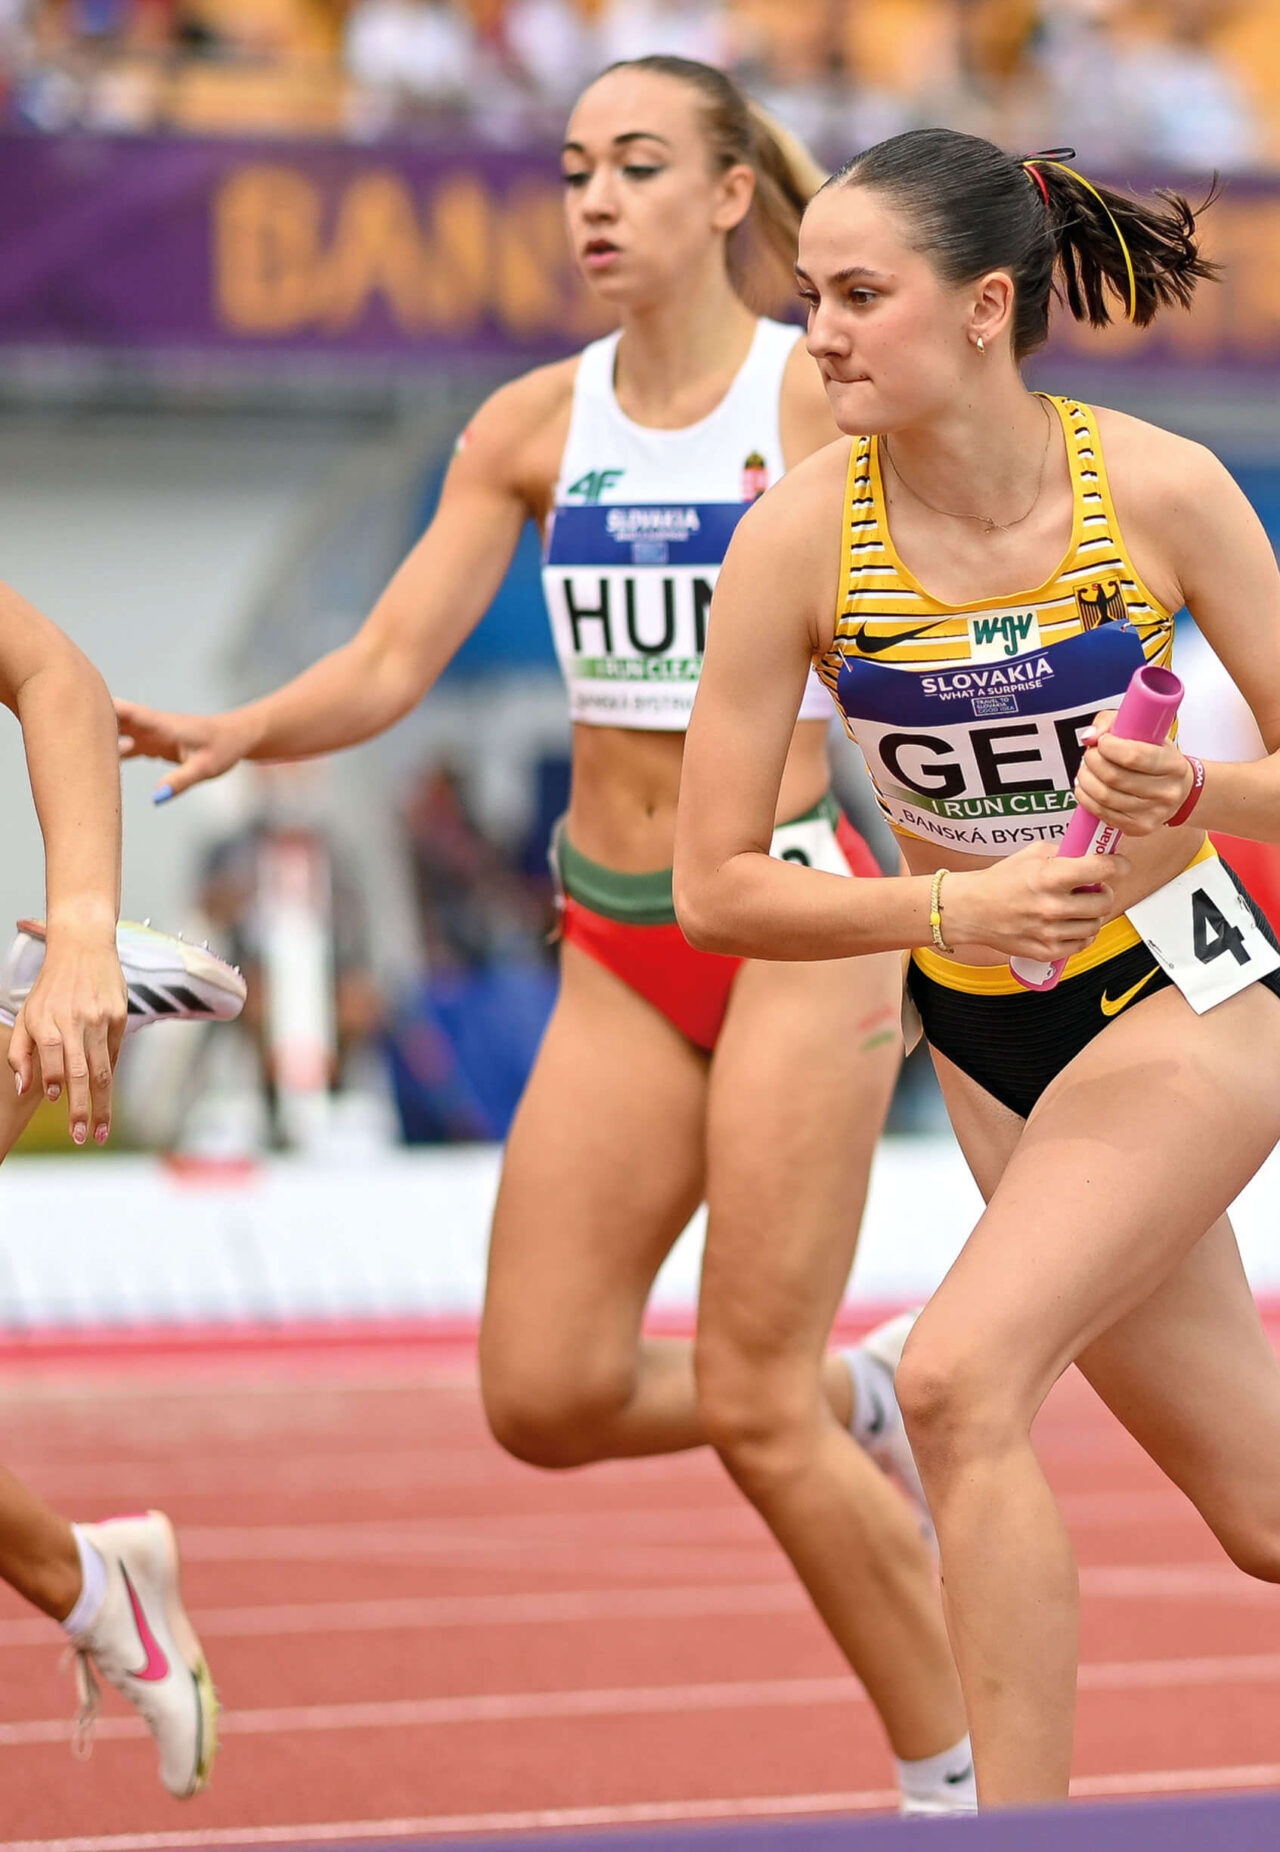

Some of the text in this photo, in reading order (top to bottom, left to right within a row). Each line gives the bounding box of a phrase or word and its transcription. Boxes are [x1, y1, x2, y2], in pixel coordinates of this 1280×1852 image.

[646, 657, 702, 679] CLEA
[920, 657, 1054, 695] SLOVAKIA
[938, 678, 1043, 702] WHAT A SURPRISE
[931, 791, 1079, 817] I RUN CLEA
[902, 809, 1067, 844] BANSKÁ BYSTR
[1093, 826, 1116, 854] olan
[1192, 888, 1251, 966] 4
